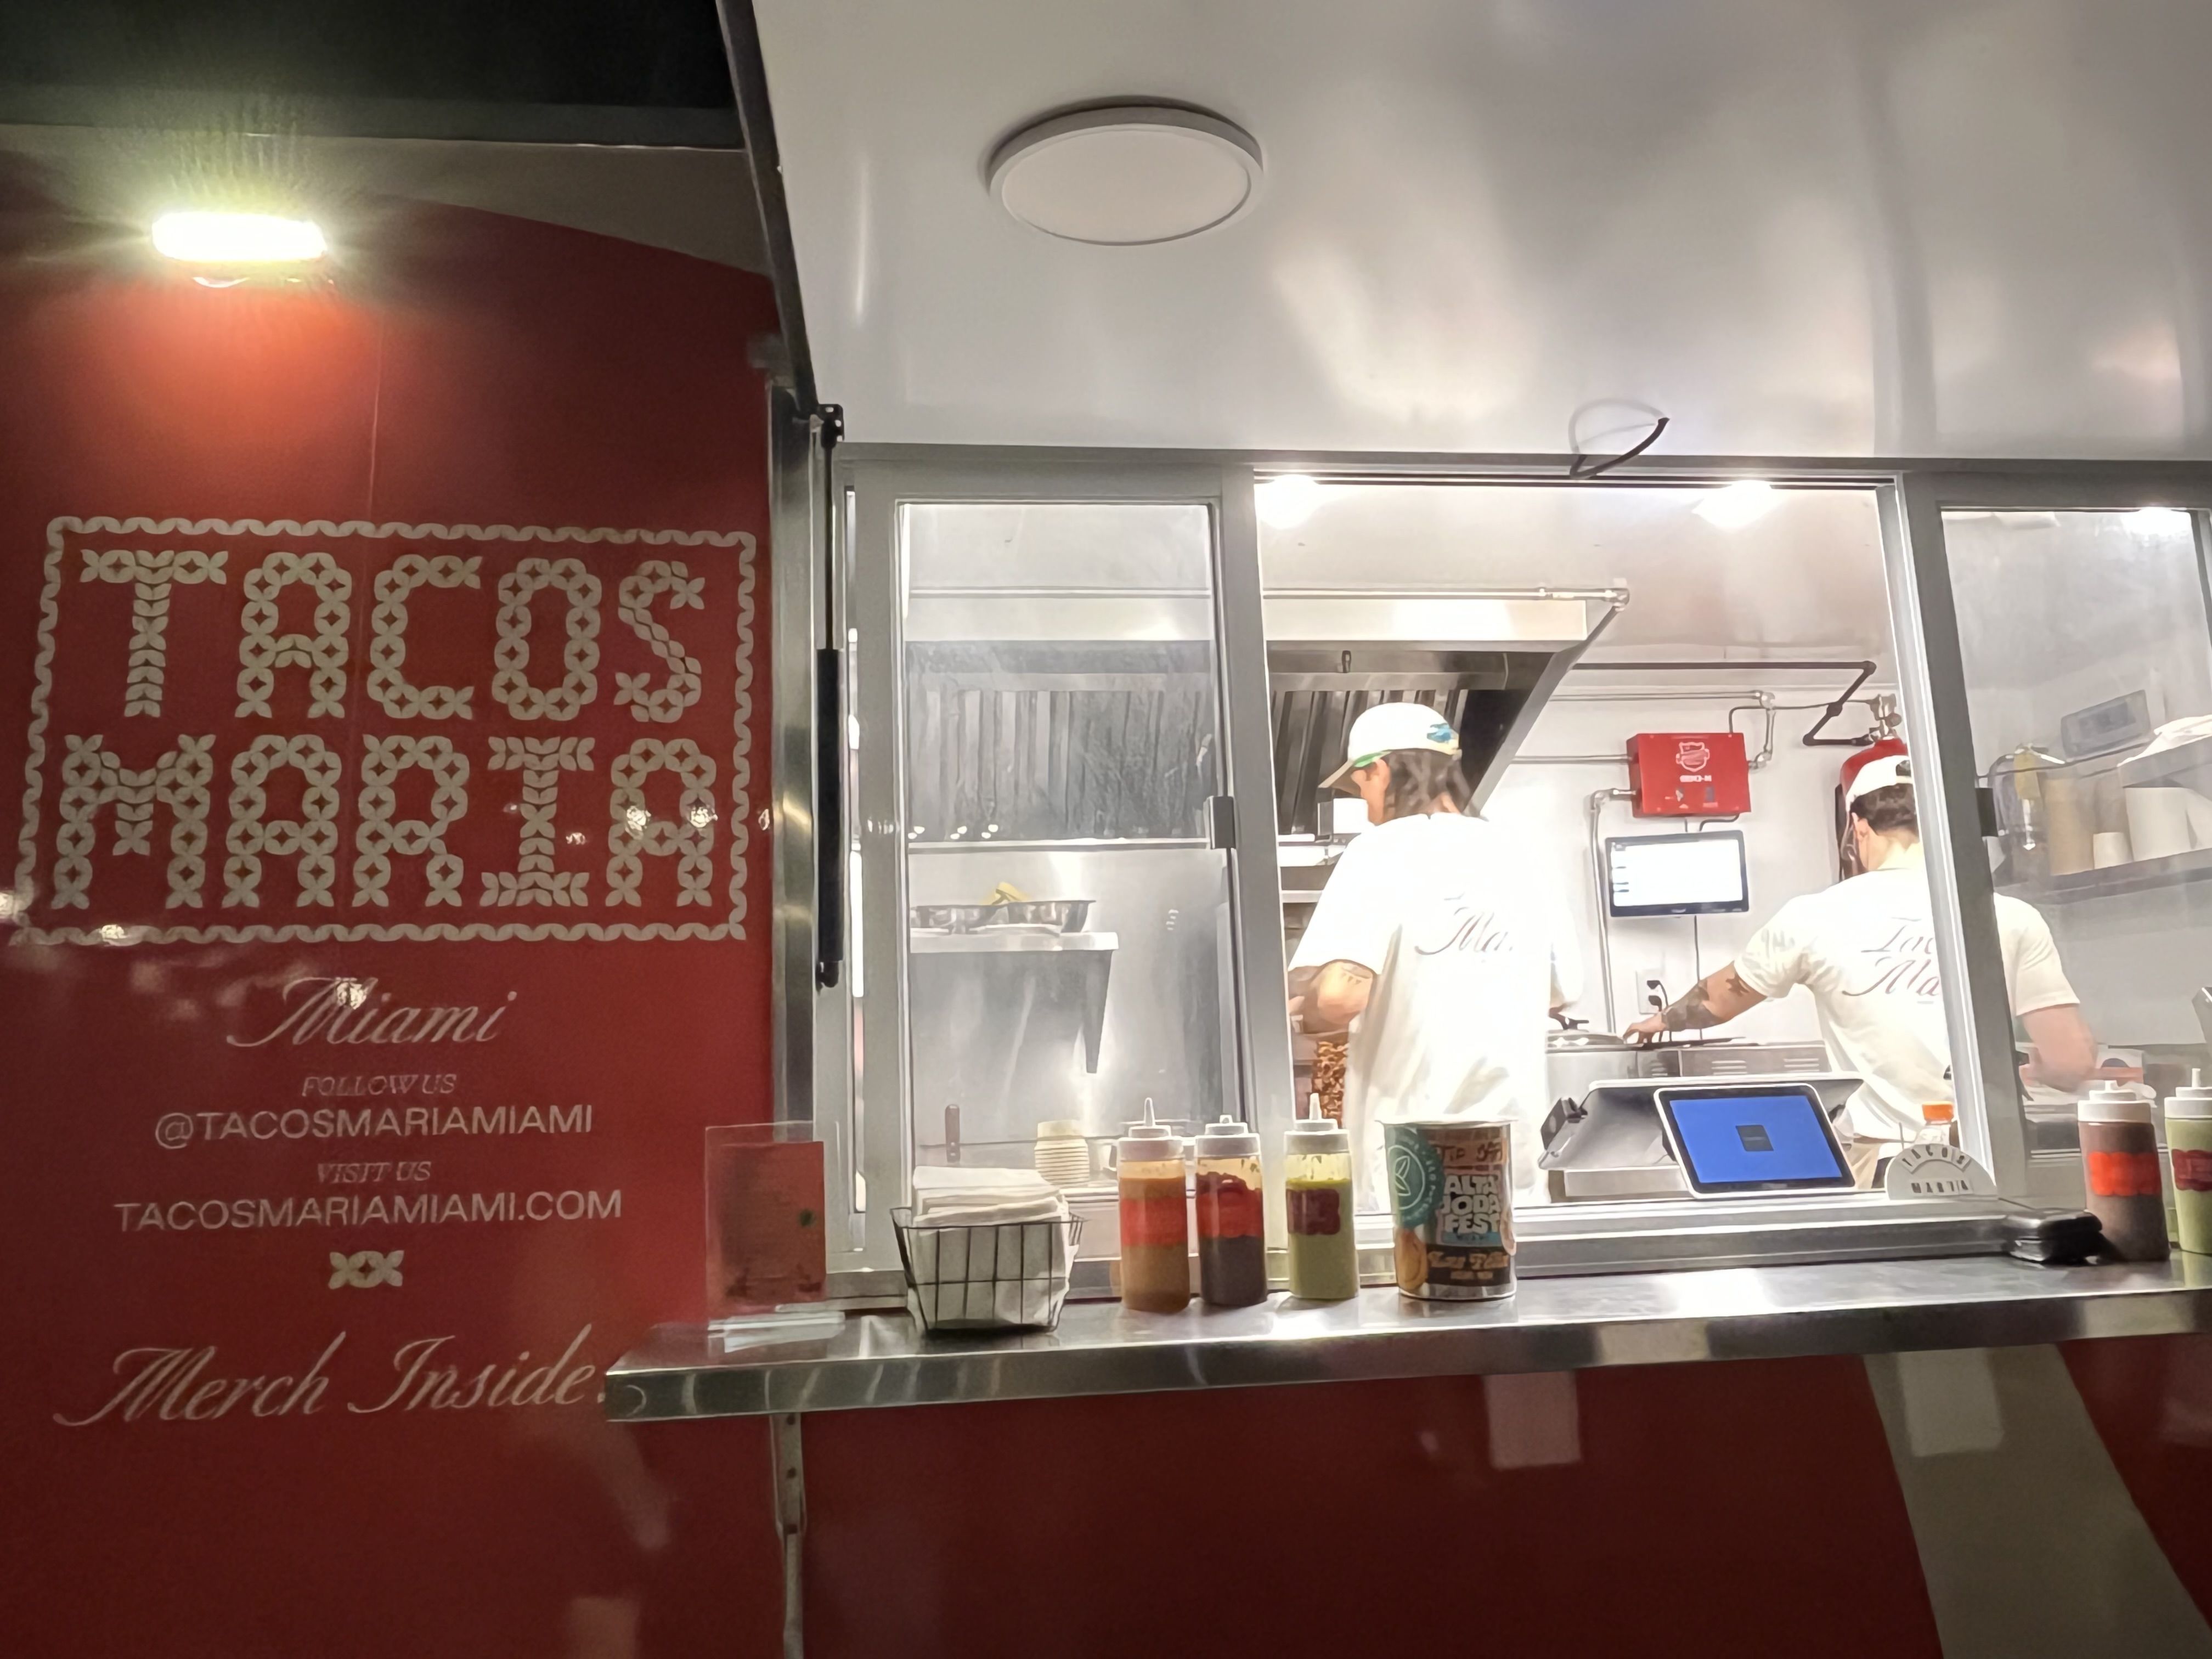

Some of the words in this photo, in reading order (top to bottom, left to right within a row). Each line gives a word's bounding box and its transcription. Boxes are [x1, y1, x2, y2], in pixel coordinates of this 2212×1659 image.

[81, 549, 706, 723] TACOS
[50, 733, 717, 908] MARIA
[226, 977, 518, 1047] Miami
[302, 1075, 419, 1097] FOLLOW
[422, 1073, 457, 1094] US
[155, 1104, 592, 1149] @TACOSMARIAMIAMI
[316, 1162, 392, 1183] VISIT
[396, 1161, 432, 1182] US
[113, 1189, 622, 1232] TACOSMARIAMIAMI.COM
[1443, 1212, 1501, 1234] FEST
[53, 1330, 346, 1427] Merch
